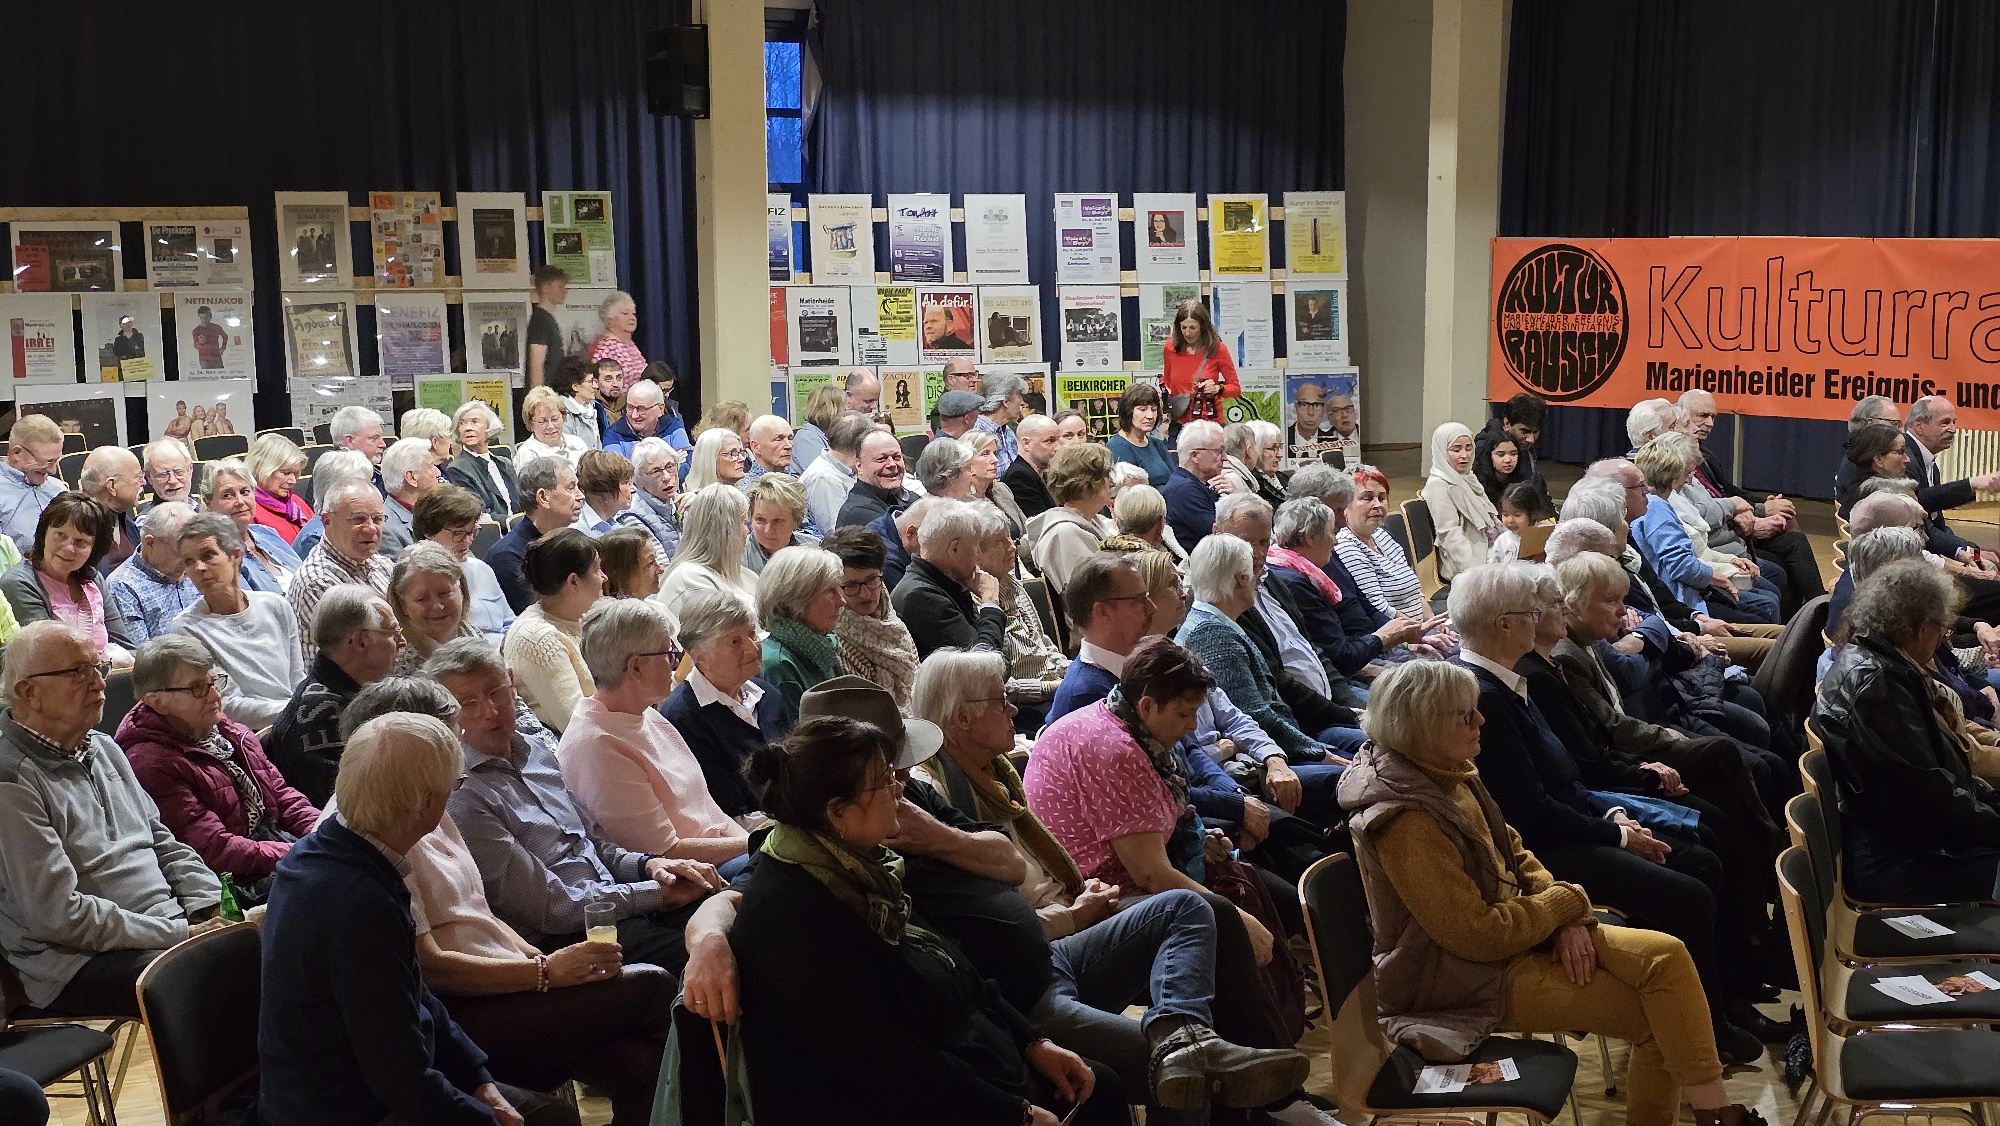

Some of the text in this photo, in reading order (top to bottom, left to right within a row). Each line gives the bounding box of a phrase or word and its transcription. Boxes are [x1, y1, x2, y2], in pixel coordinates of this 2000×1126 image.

[1505, 252, 1619, 314] KULTUR
[922, 294, 973, 308] Ab dafür!
[1504, 314, 1568, 324] MARIENHEIDER
[1504, 322, 1618, 332] UND ERLEBNISINITIATIVE
[1505, 330, 1619, 392] RAUSCH
[1067, 380, 1126, 392] BEIKIRCHER
[1646, 362, 1816, 398] Marienheider
[1824, 368, 1947, 404] Ereignis-
[1291, 440, 1356, 452] Durchstarten
